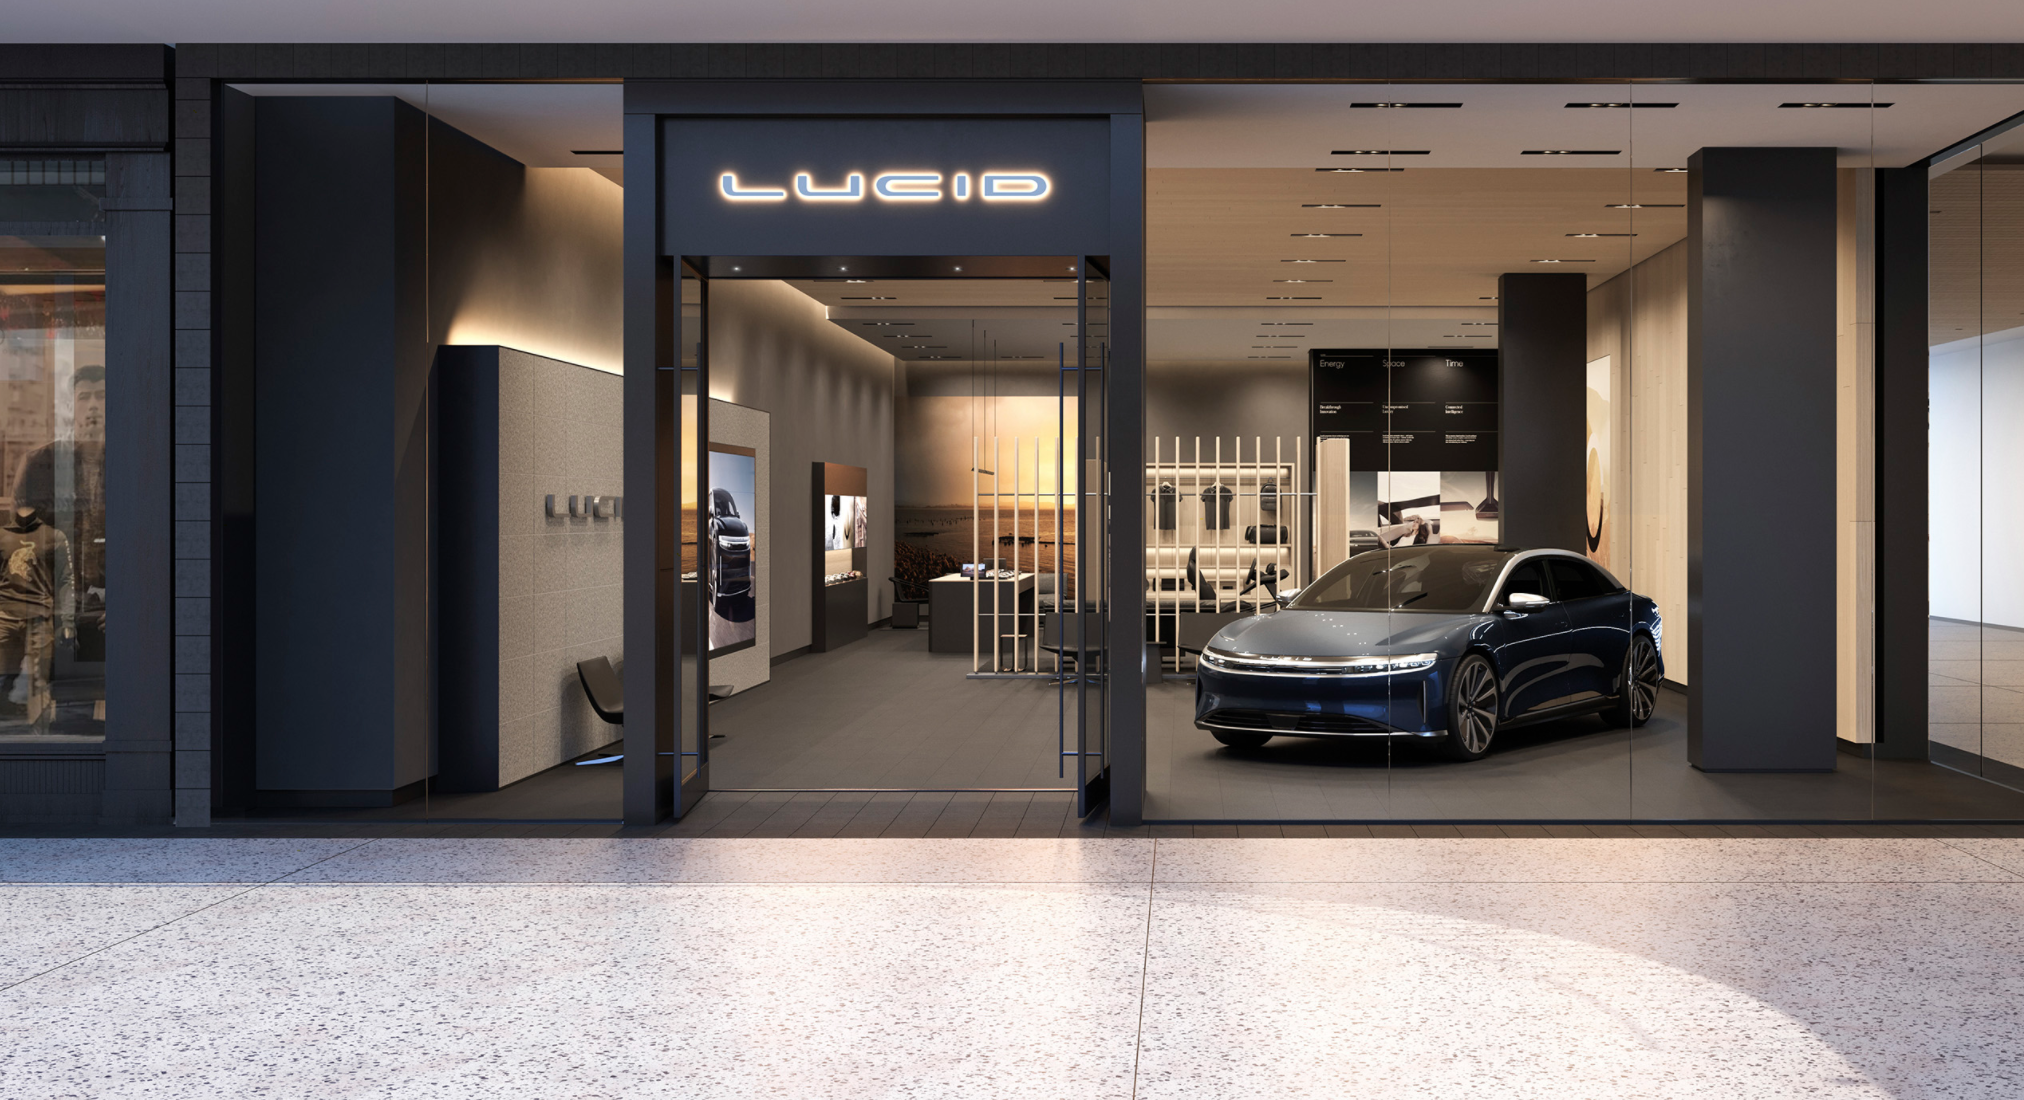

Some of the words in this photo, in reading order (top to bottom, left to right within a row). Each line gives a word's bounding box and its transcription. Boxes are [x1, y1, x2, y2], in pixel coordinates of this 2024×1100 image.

[720, 173, 1050, 199] LUCID
[1320, 360, 1345, 369] Energy
[1382, 360, 1405, 368] Space
[1445, 359, 1464, 368] Time
[545, 494, 623, 518] LUCI
